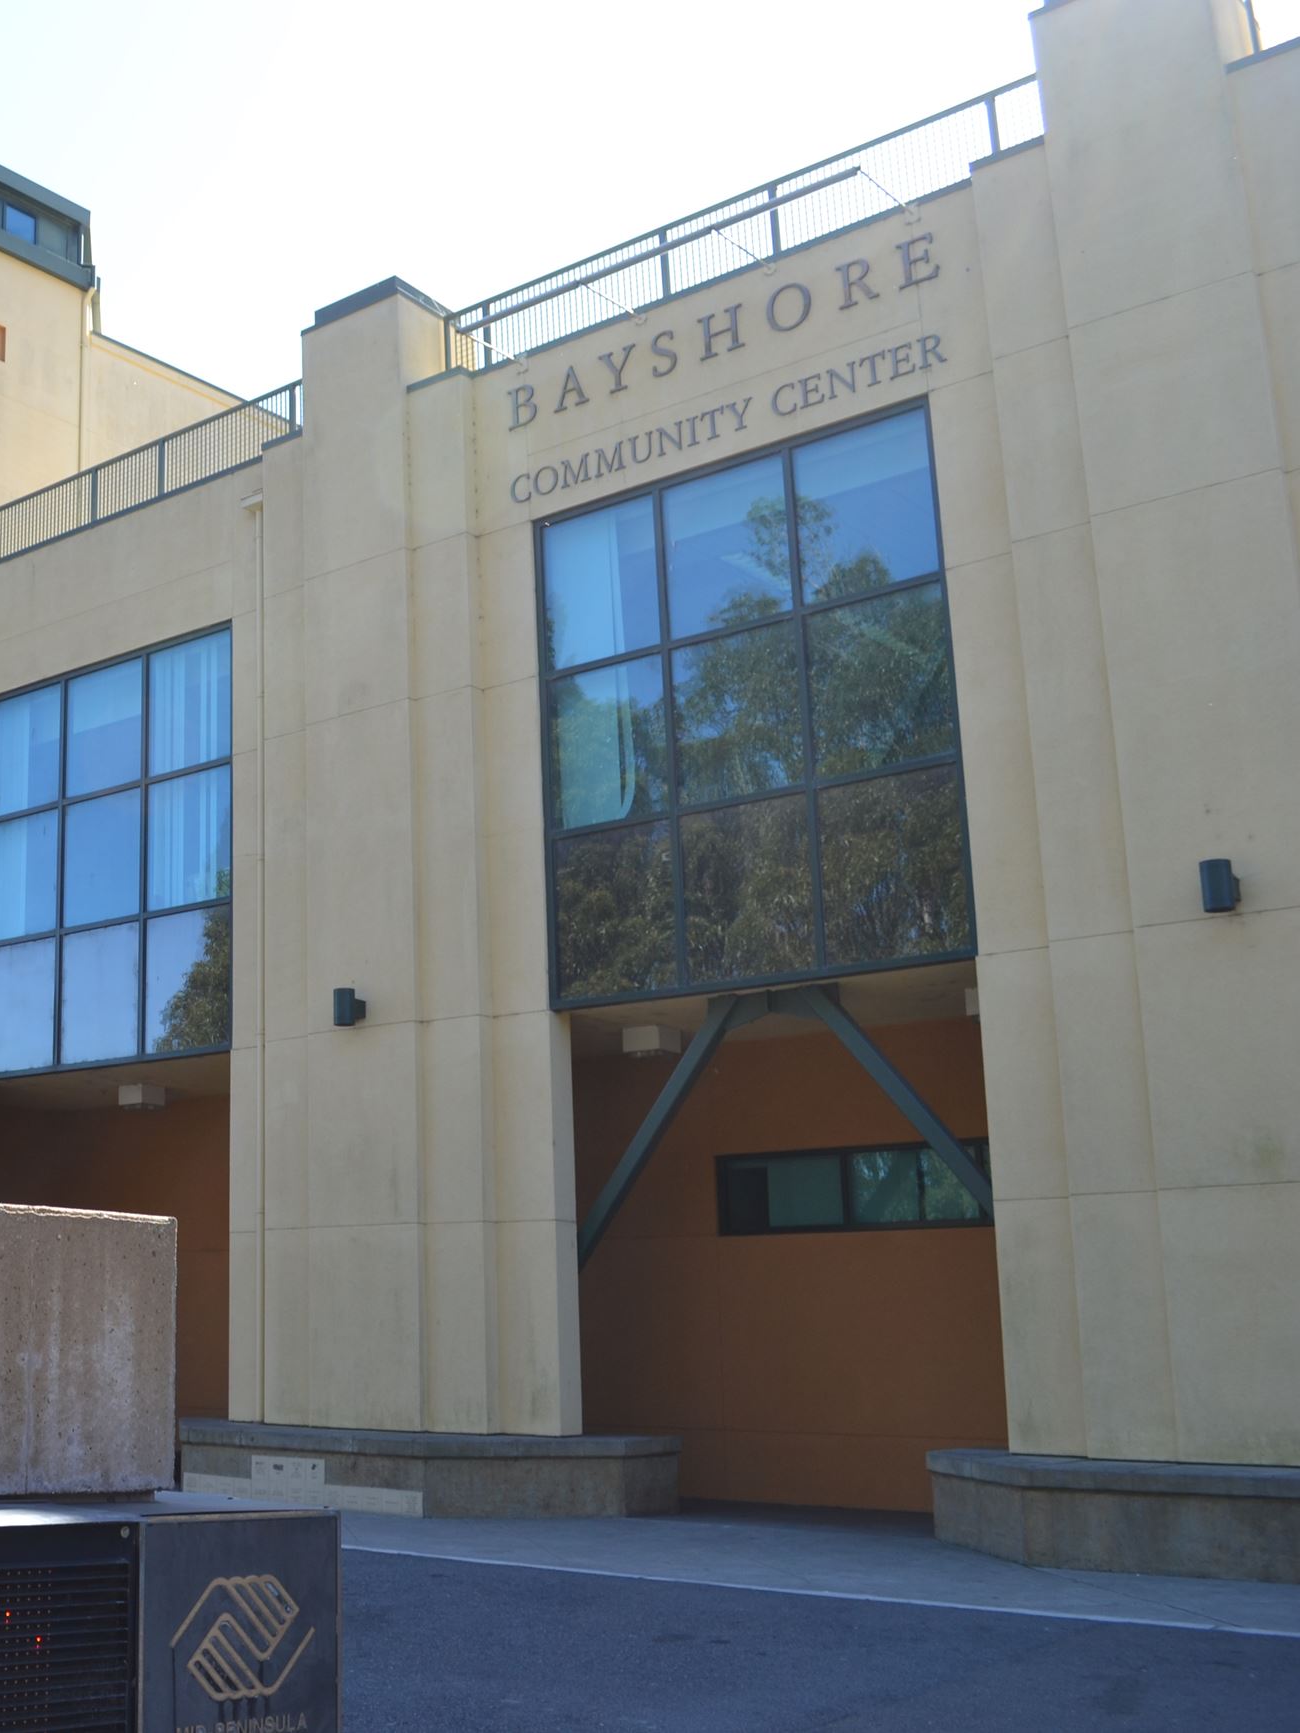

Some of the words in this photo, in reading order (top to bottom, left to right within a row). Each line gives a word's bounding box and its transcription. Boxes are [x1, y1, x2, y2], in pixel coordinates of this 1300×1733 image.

[507, 232, 941, 432] BAYSHORE
[510, 396, 753, 504] COMMUNITY
[771, 333, 947, 416] CENTER
